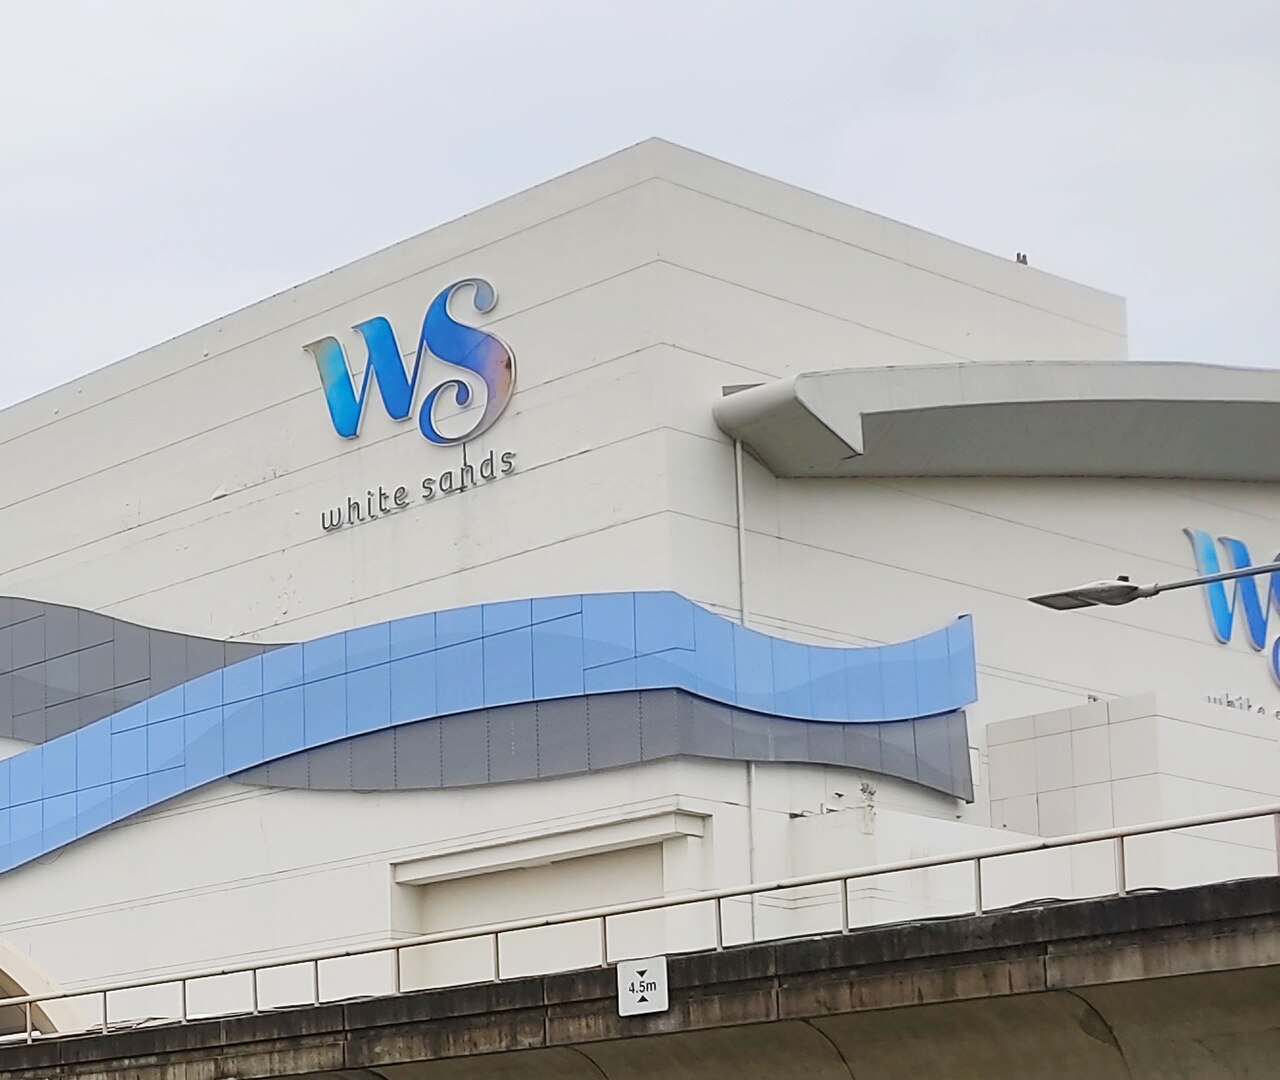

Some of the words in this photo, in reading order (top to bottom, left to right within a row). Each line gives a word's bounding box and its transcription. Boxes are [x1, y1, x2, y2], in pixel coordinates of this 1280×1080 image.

[302, 278, 516, 446] WS
[321, 486, 408, 531] white
[422, 450, 517, 499] sands
[628, 981, 657, 994] 4.5m
